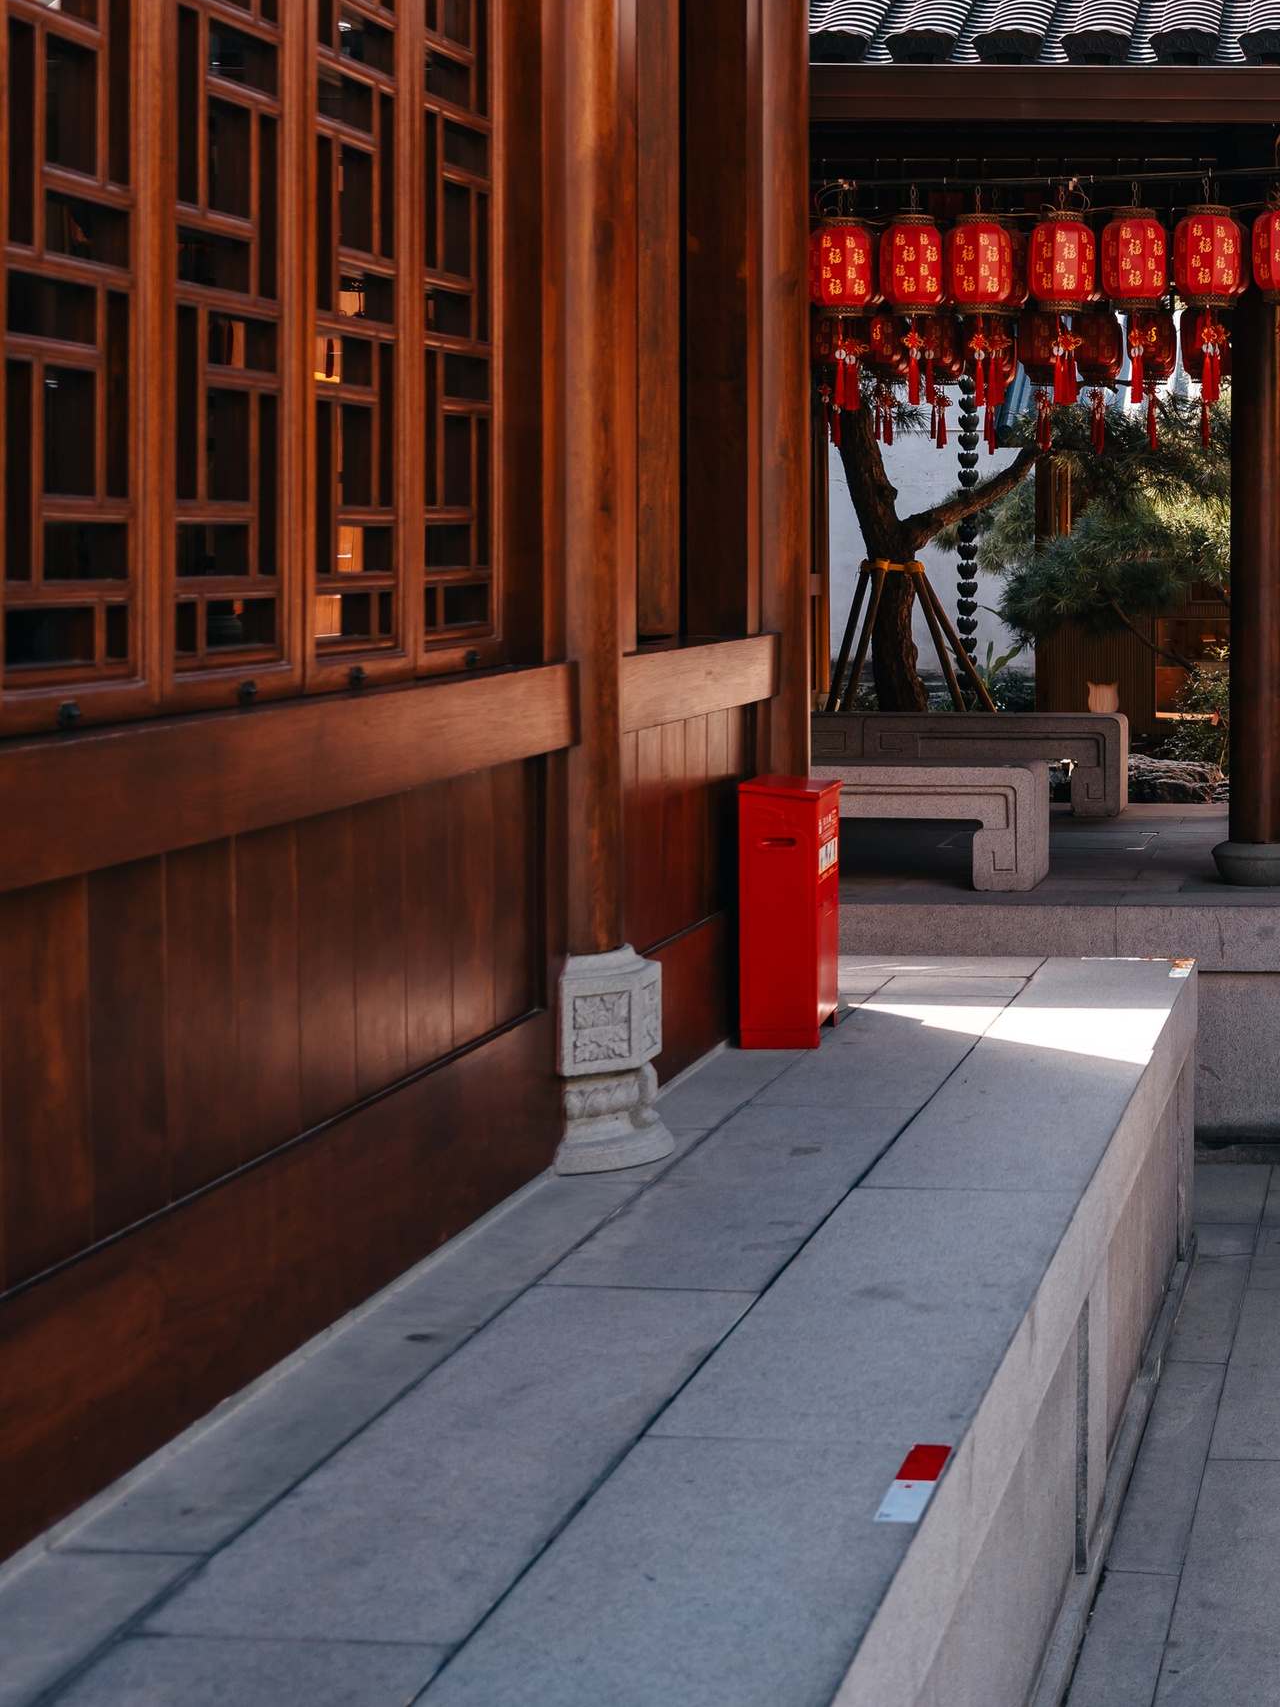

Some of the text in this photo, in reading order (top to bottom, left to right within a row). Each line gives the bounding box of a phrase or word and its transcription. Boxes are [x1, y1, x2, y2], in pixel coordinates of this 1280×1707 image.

[1056, 231, 1066, 242] 福
[1081, 232, 1088, 243] 福
[1121, 227, 1131, 239] 福
[1147, 228, 1155, 239] 福
[1192, 224, 1203, 236] 福
[1217, 226, 1225, 237] 福
[823, 236, 832, 248] 福
[846, 236, 855, 248] 福
[896, 234, 905, 246] 福
[920, 233, 929, 245] 福
[956, 233, 965, 245] 福
[980, 234, 989, 245] 福
[1199, 237, 1211, 253] 福
[1223, 238, 1234, 254] 福
[1259, 234, 1267, 249] 福
[903, 246, 915, 262] 福
[926, 246, 938, 262] 福
[962, 246, 974, 261] 福
[986, 246, 999, 262] 福
[1042, 243, 1052, 258] 福
[1063, 244, 1076, 259] 福
[1086, 245, 1094, 260] 福
[1129, 239, 1142, 256] 福
[1153, 240, 1163, 256] 福
[828, 248, 842, 264] 福
[853, 249, 865, 265] 福
[1121, 257, 1131, 270] 福
[1191, 255, 1201, 267] 福
[1216, 256, 1225, 268] 福
[896, 265, 905, 276] 福
[920, 264, 929, 275] 福
[956, 264, 965, 276] 福
[980, 264, 990, 276] 福
[1055, 261, 1066, 273] 福
[1082, 262, 1087, 274] 福
[1148, 258, 1155, 270] 福
[823, 267, 832, 279] 福
[847, 267, 857, 279] 福
[1128, 270, 1142, 286] 福
[1153, 271, 1162, 287] 福
[1198, 268, 1211, 284] 福
[1222, 270, 1233, 285] 福
[1260, 264, 1269, 280] 福
[829, 279, 842, 295] 福
[854, 280, 865, 295] 福
[903, 277, 916, 293] 福
[926, 277, 938, 293] 福
[963, 276, 975, 292] 福
[987, 277, 999, 293] 福
[1042, 273, 1052, 289] 福
[1062, 274, 1075, 290] 福
[1085, 275, 1092, 291] 福
